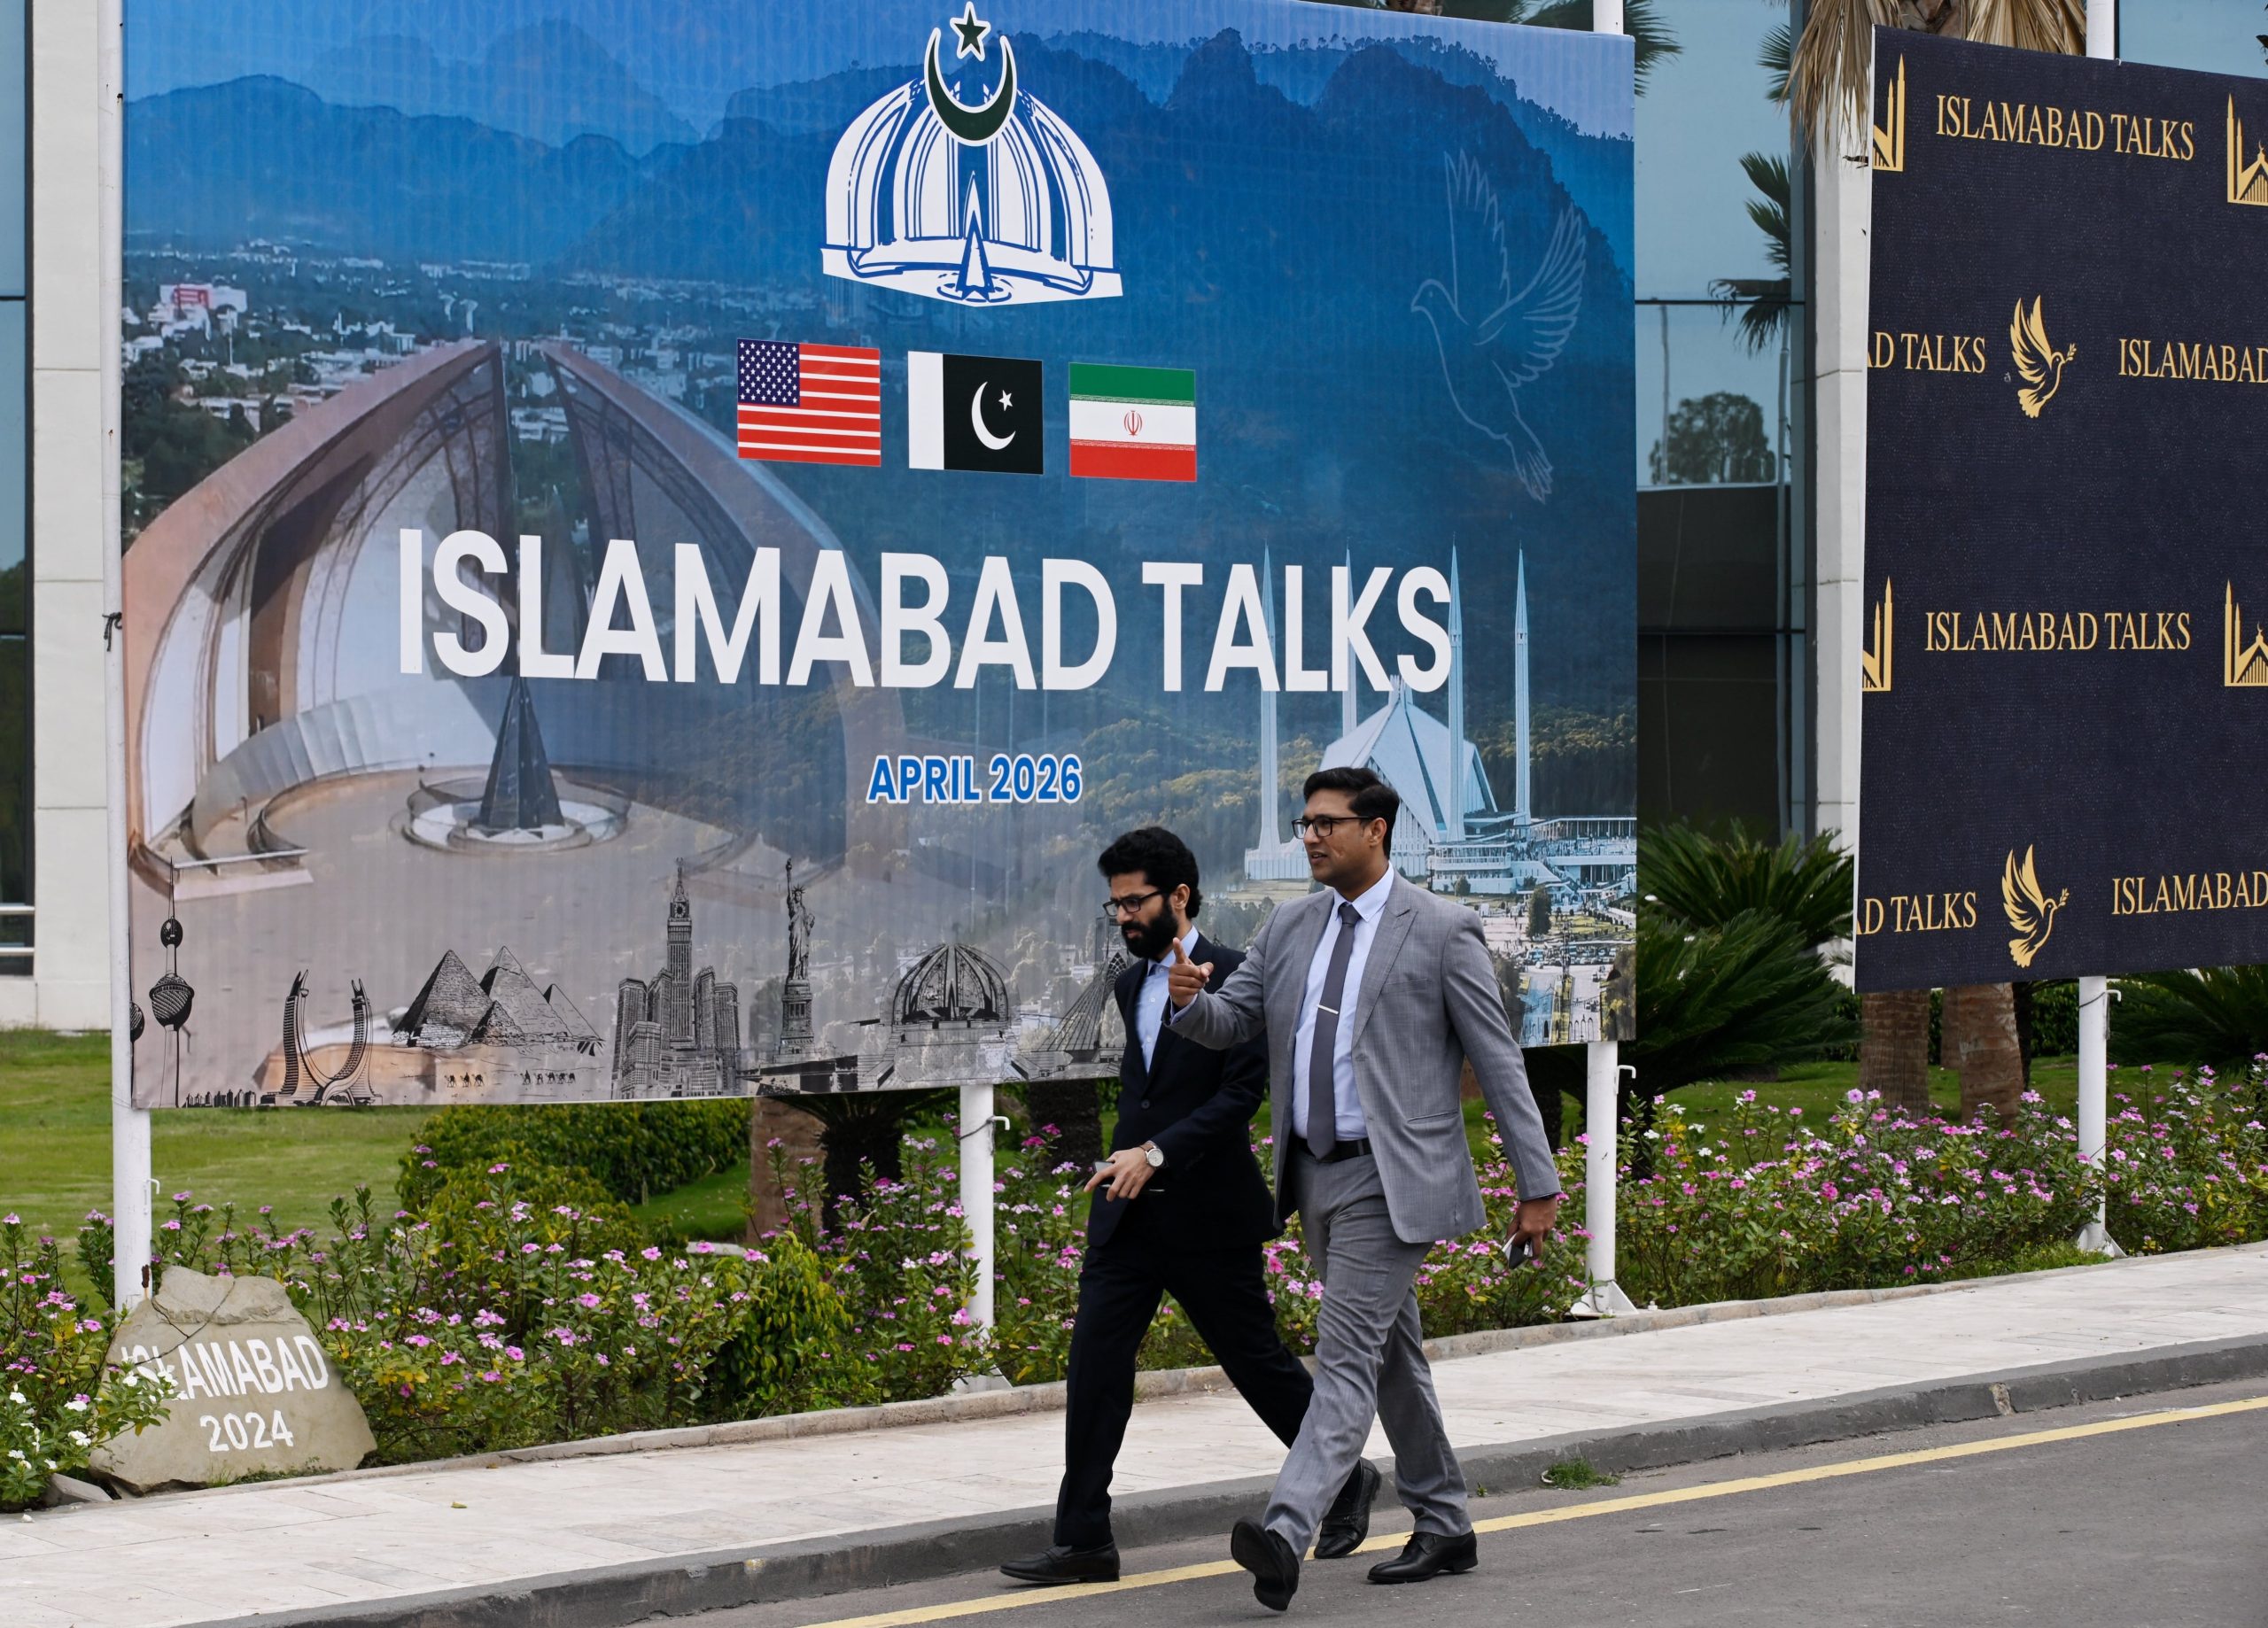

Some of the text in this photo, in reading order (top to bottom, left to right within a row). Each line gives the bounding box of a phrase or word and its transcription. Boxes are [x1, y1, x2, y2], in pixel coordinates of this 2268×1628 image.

[1937, 94, 2194, 161] ISLAMABAD TALKS
[1900, 333, 1985, 373] TALKS
[399, 529, 1452, 693] ISLAMABAD TALKS
[1924, 611, 2191, 651] ISLAMABAD TALKS
[866, 753, 1083, 804] APRIL 2026
[1890, 891, 1977, 932] TALKS
[2111, 871, 2268, 915] ISLAMABAD
[200, 1409, 293, 1452] 2024
